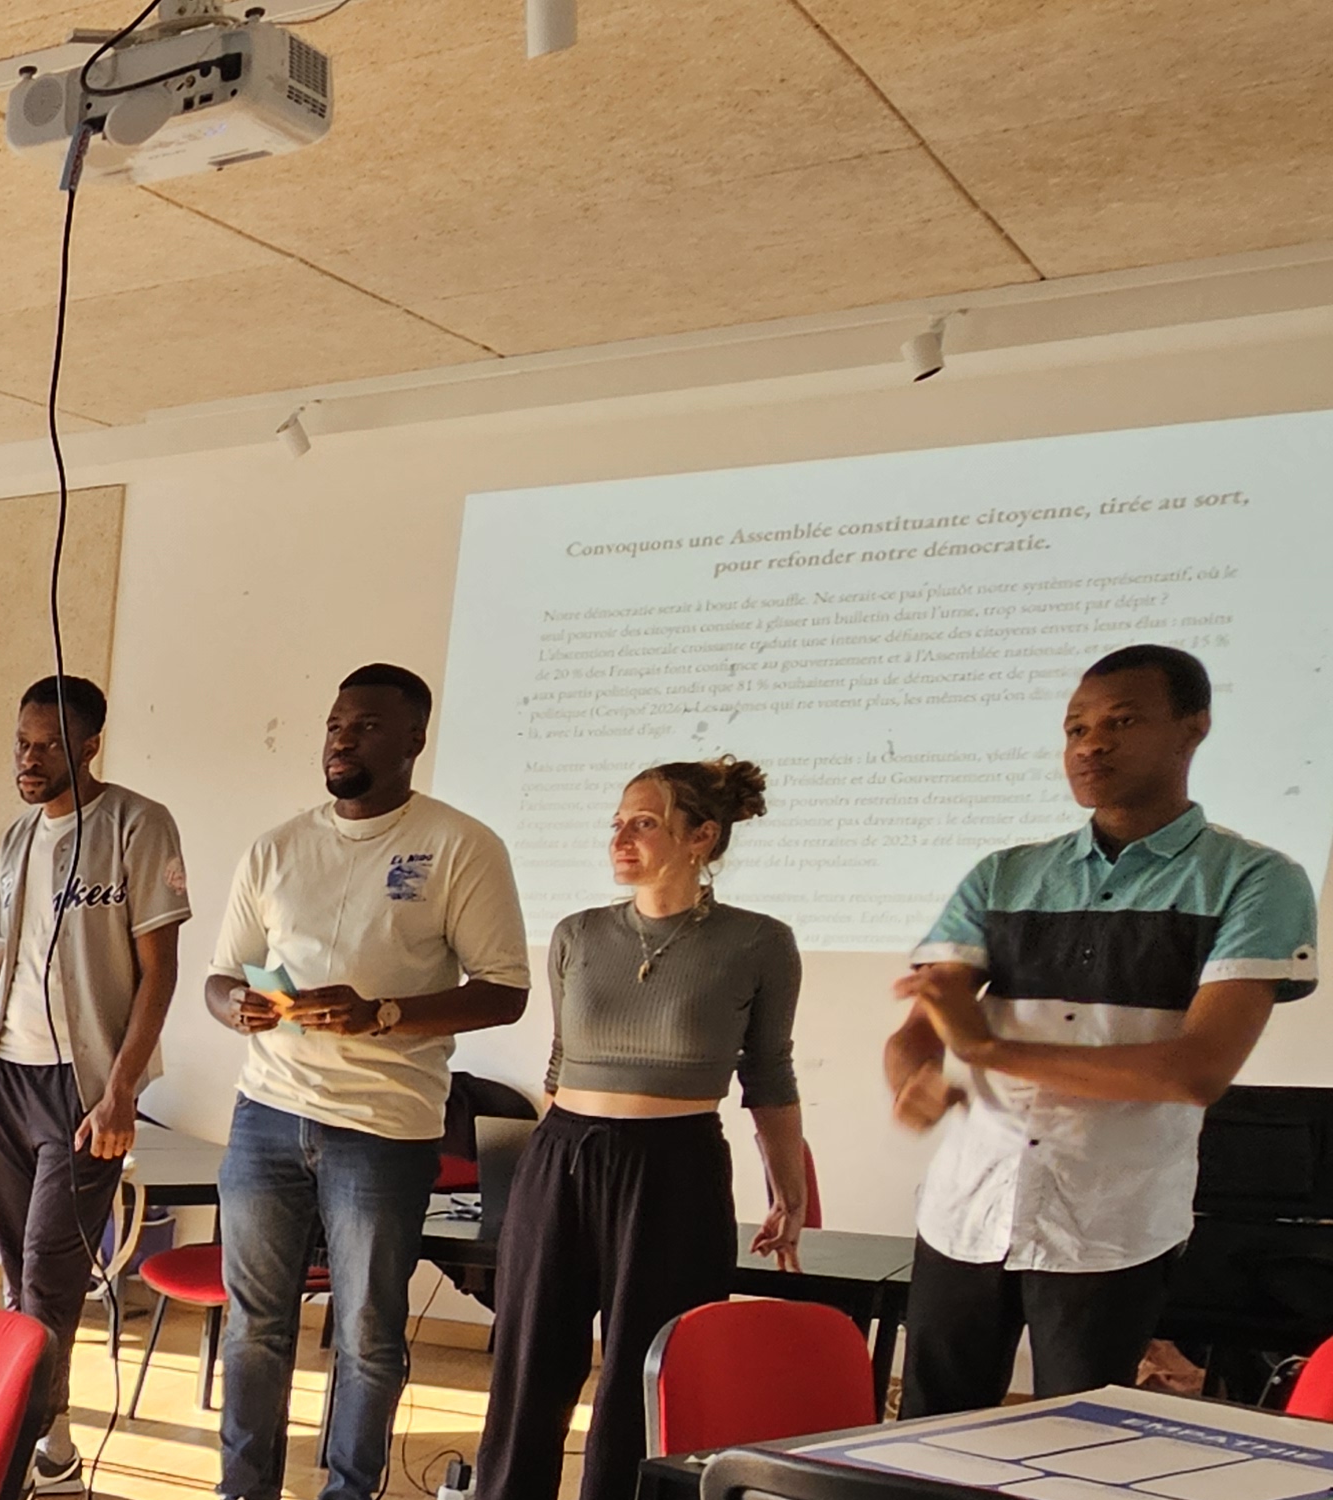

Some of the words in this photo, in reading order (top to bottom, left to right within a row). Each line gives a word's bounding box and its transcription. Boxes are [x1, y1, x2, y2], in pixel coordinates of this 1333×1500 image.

[565, 536, 683, 558] Convoquons
[688, 533, 724, 548] une
[729, 521, 833, 545] Assemblée
[837, 510, 971, 536] constituante
[975, 504, 1091, 528] citoyenne,
[1099, 495, 1153, 516] tirée
[1158, 496, 1187, 512] au
[1193, 487, 1251, 511] sort,
[713, 558, 763, 577] pour
[767, 548, 856, 572] refonder
[860, 544, 918, 563] notre
[923, 534, 1052, 559] démocratie.
[583, 603, 656, 619] démocratie
[657, 600, 693, 615] serait
[695, 599, 703, 612] à
[705, 597, 739, 612] bout
[740, 596, 758, 610] de
[812, 592, 835, 605] Ne
[899, 590, 921, 604] pas
[926, 583, 973, 602] plutôt
[977, 581, 1017, 596] notre
[1021, 577, 1083, 596] système
[1085, 569, 1193, 592] représentatif,
[1196, 567, 1220, 583] où
[619, 625, 642, 637] des
[811, 617, 831, 627] un
[833, 611, 889, 626] bulletin
[893, 610, 928, 623] dans
[982, 605, 1017, 620] trop
[1020, 600, 1081, 616] souvent
[1084, 602, 1111, 616] par
[1113, 595, 1157, 614] dépit
[801, 638, 825, 648] une
[829, 632, 881, 647] intense
[884, 629, 944, 647] défiance
[947, 627, 971, 641] des
[975, 625, 1037, 642] citoyens
[1040, 625, 1089, 637] envers
[1092, 619, 1132, 634] leurs
[1180, 614, 1233, 630] moins
[585, 666, 607, 678] des
[781, 652, 883, 672] gouvernement
[887, 651, 900, 664] et
[903, 651, 912, 664] à
[914, 647, 999, 663] l'Assemblée
[707, 683, 733, 696] que
[848, 674, 879, 690] plus
[882, 673, 900, 685] de
[903, 670, 985, 684] démocratie
[987, 668, 1002, 681] et
[1005, 668, 1025, 680] de
[769, 697, 794, 714] qui
[796, 700, 814, 709] ne
[817, 694, 863, 708] votent
[903, 693, 922, 705] les
[925, 691, 977, 705] mêmes
[813, 752, 855, 769] précis
[865, 751, 877, 764] la
[781, 773, 849, 786] Président
[849, 773, 863, 785] et
[865, 772, 887, 785] du
[889, 770, 1002, 784] Gouvernement
[853, 792, 919, 806] restreints
[836, 817, 859, 829] pas
[863, 812, 935, 828] davantage
[776, 835, 799, 847] des
[860, 835, 879, 847] de
[881, 834, 917, 847] 2023
[1120, 1417, 1325, 1463] EMPATHIE
